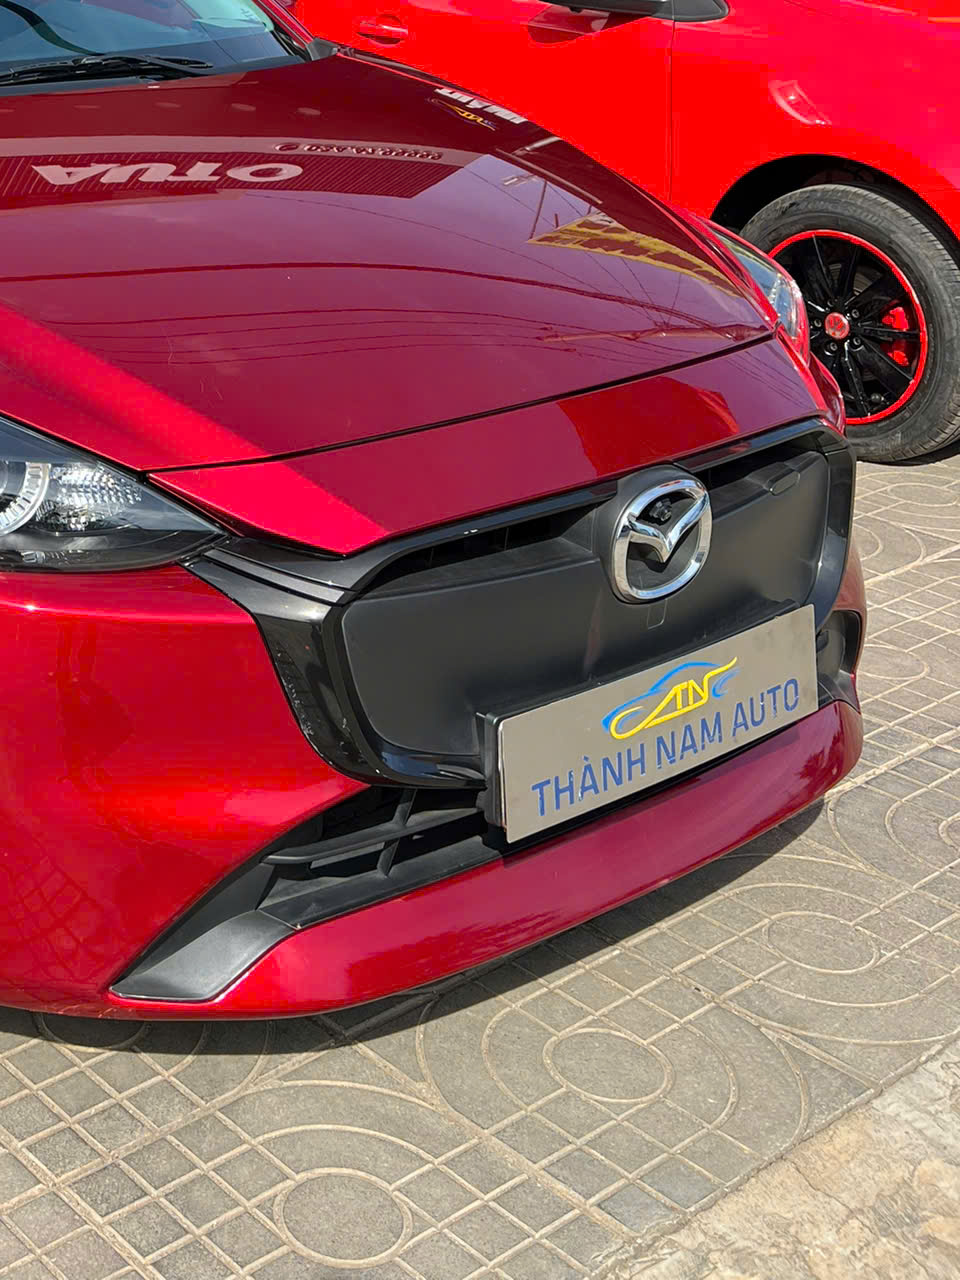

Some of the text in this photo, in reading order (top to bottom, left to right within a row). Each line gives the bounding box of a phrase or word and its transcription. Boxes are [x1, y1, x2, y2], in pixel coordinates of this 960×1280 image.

[530, 678, 800, 817] THÀNH NAM AUTO
